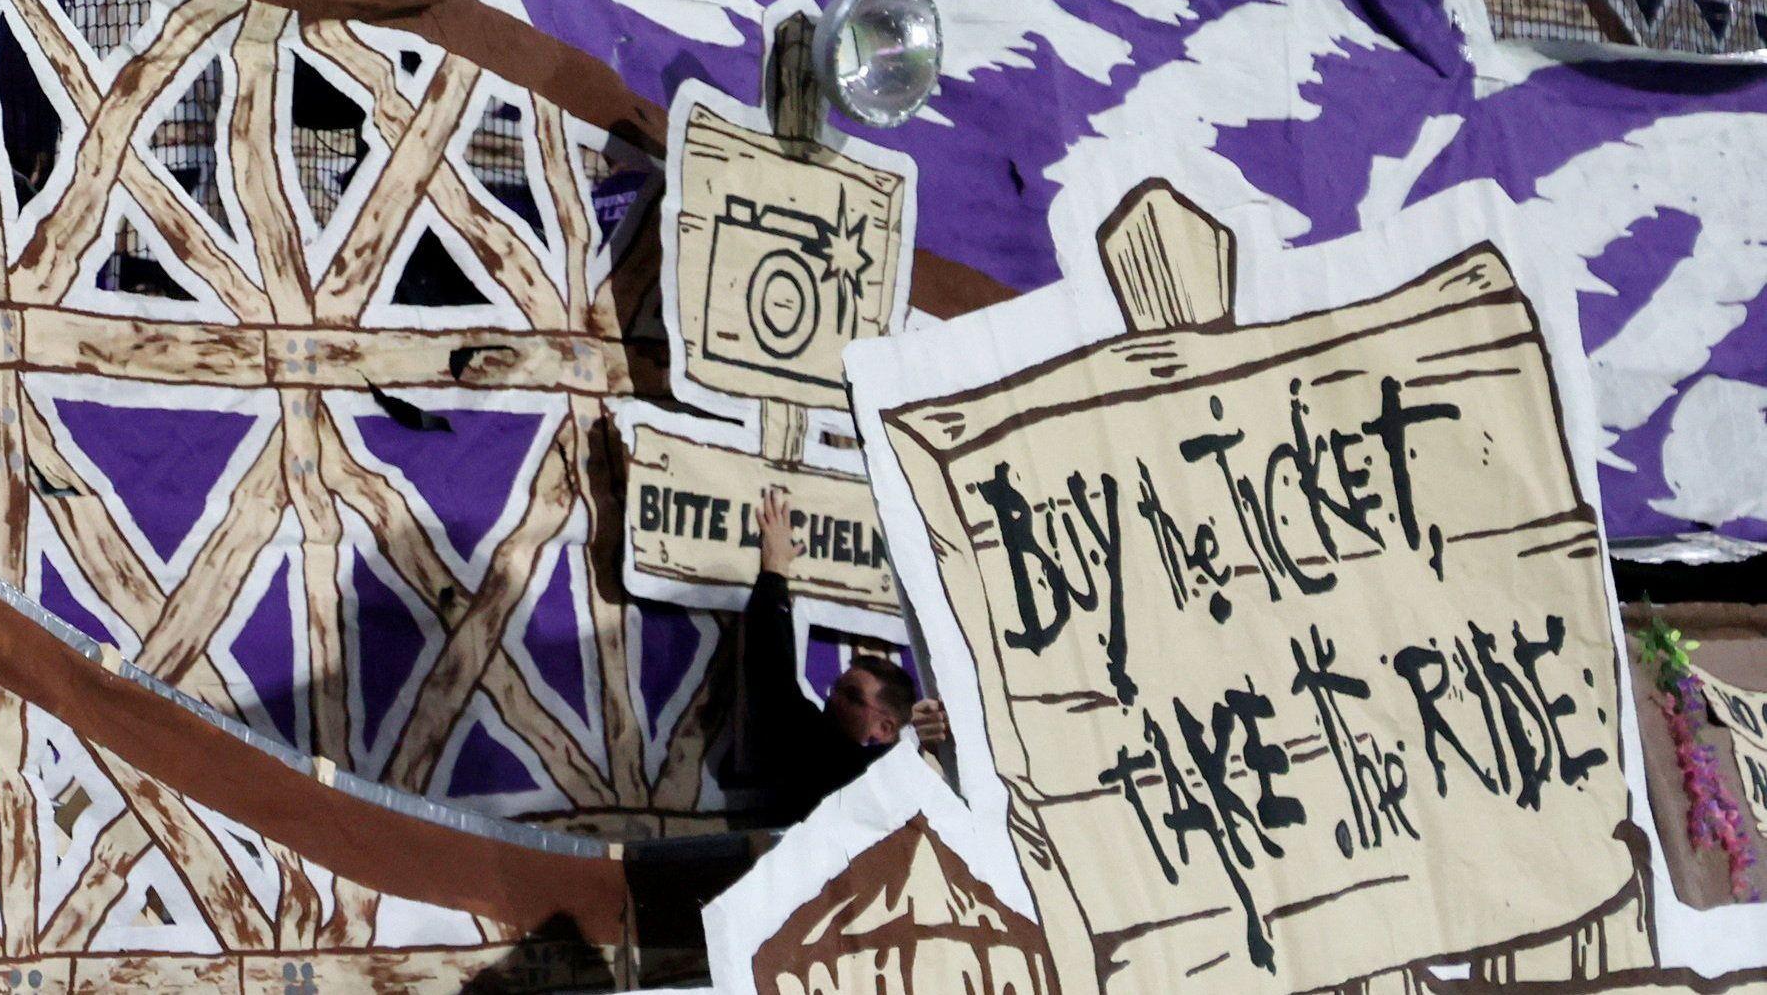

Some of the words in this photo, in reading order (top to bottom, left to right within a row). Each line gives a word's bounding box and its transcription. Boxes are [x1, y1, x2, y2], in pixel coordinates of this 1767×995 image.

[640, 484, 730, 541] BITTE
[976, 462, 1138, 704] BUY
[1098, 676, 1307, 973] TAKE
